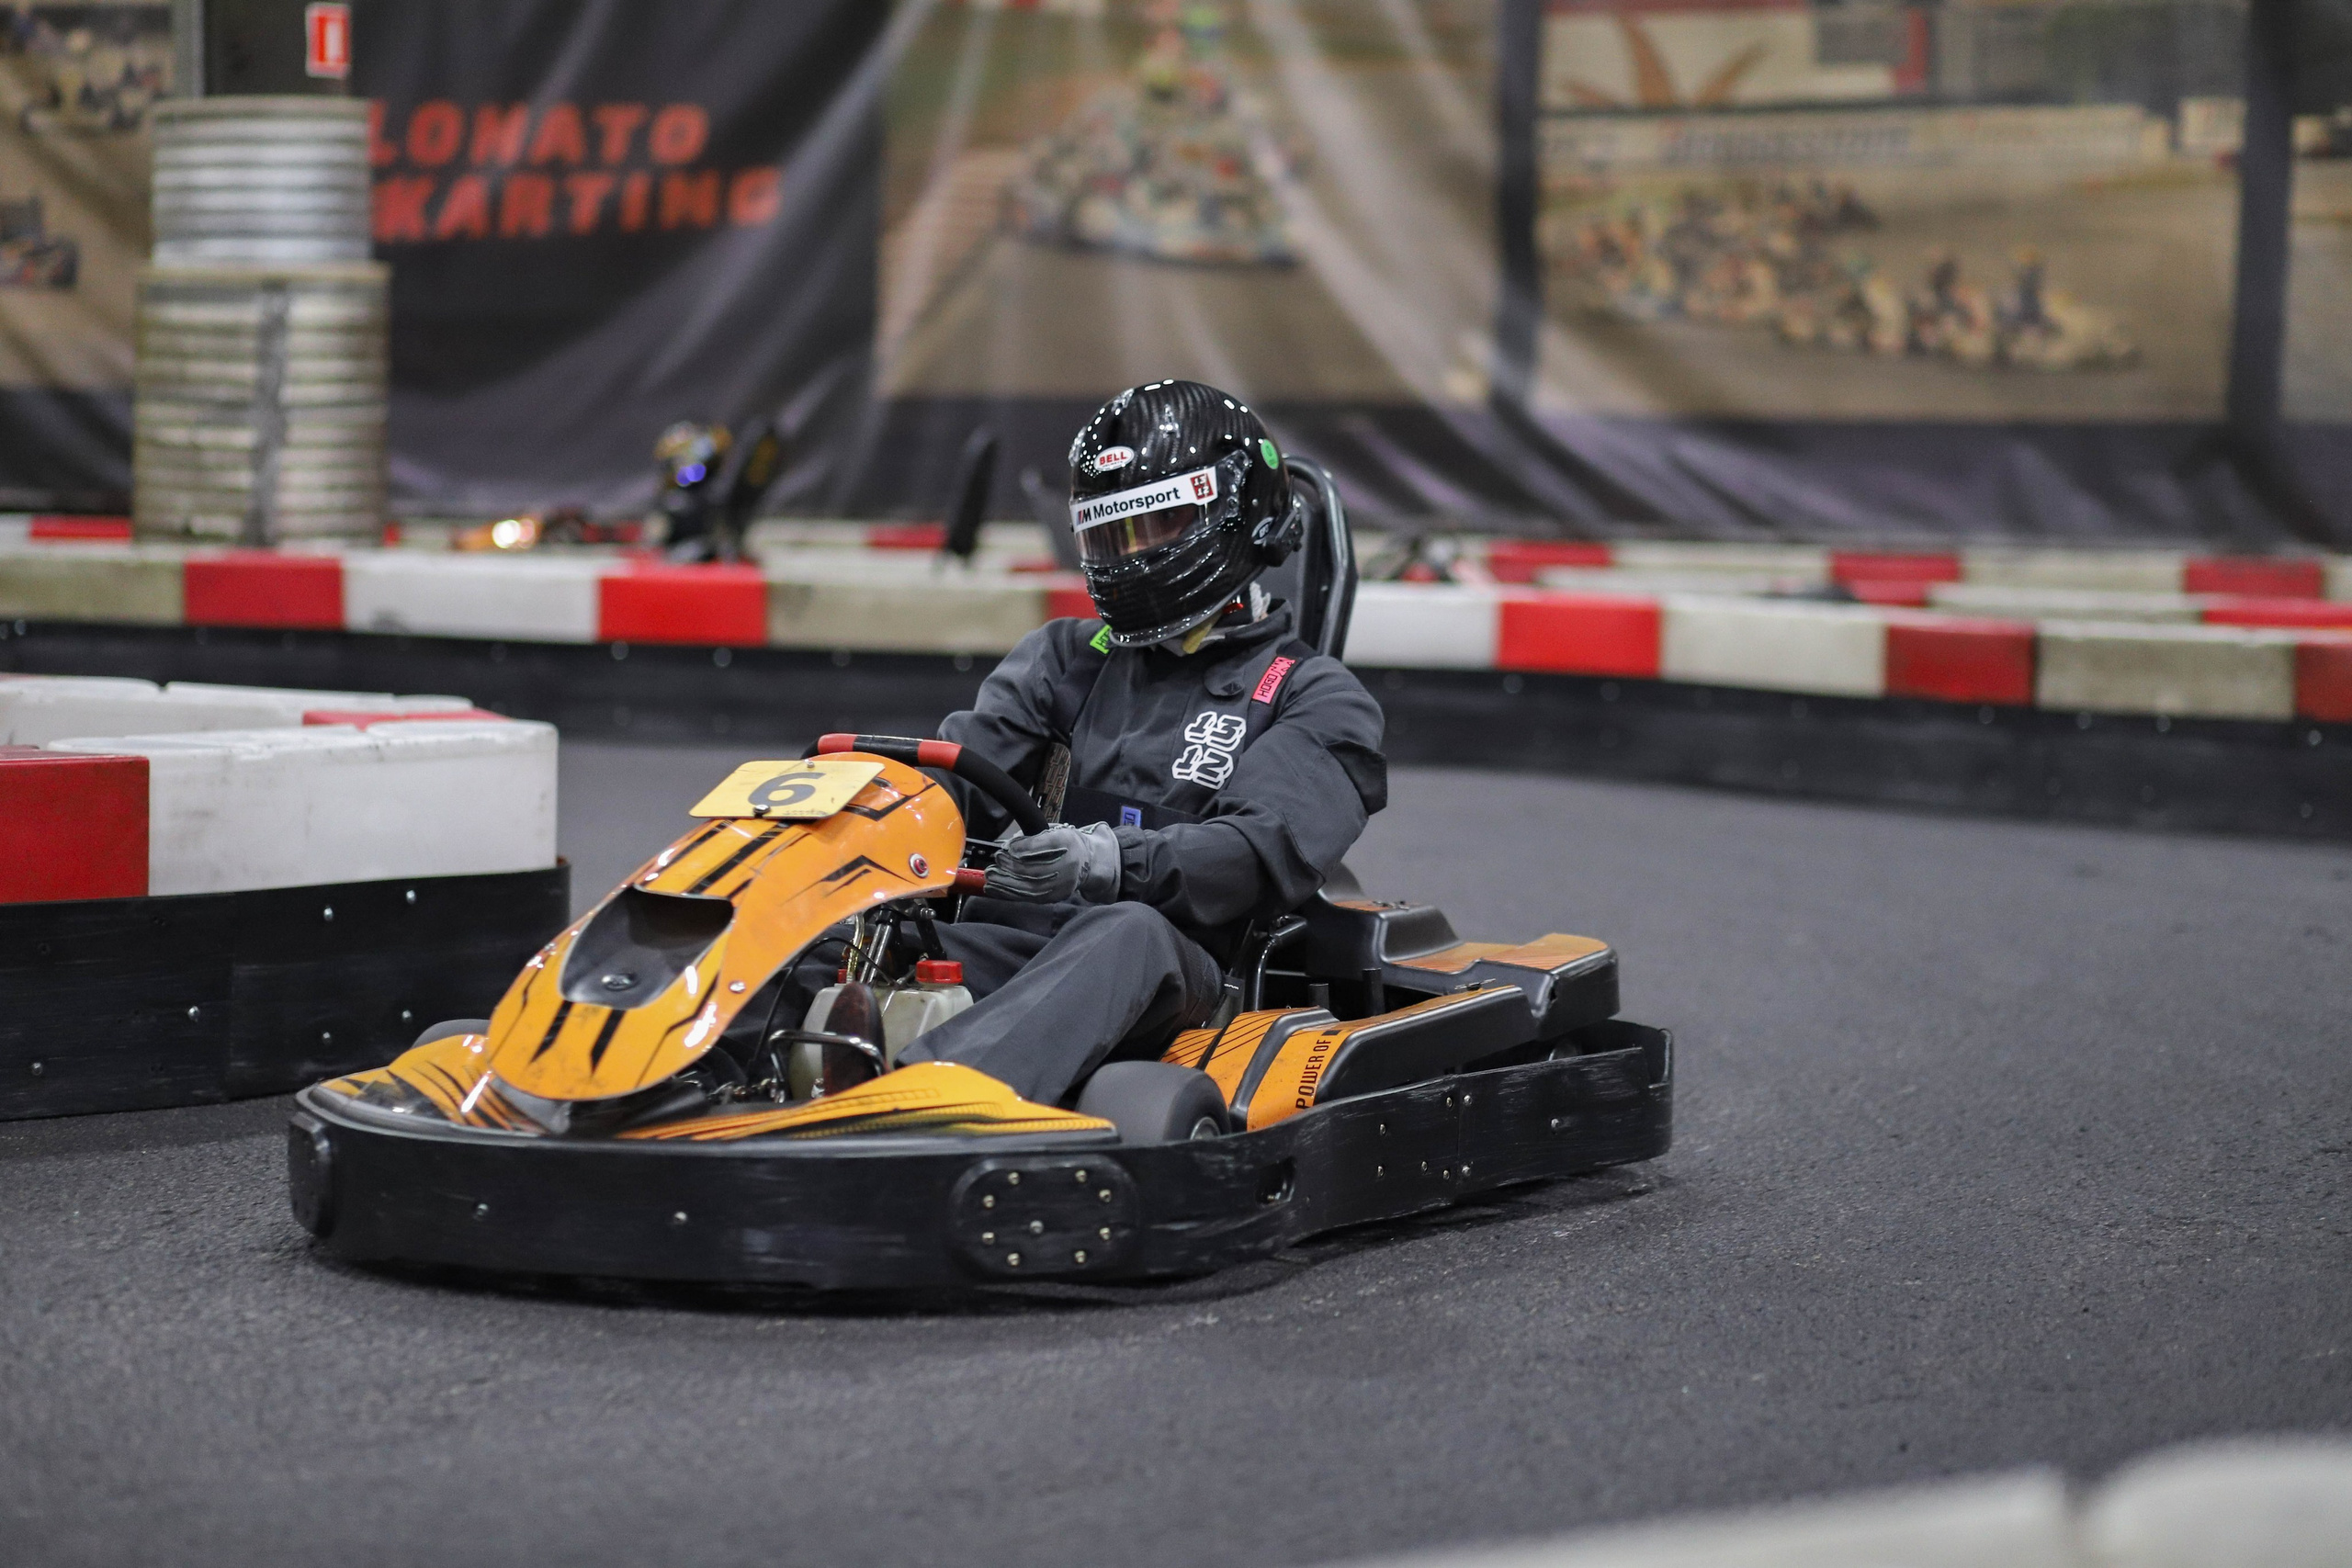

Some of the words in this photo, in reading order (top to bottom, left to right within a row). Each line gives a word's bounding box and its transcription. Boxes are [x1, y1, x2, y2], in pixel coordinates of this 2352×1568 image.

[371, 166, 785, 242] KARTING
[1099, 451, 1127, 466] BELL
[1093, 487, 1181, 519] Motorsport
[1197, 486, 1211, 497] 12
[1257, 673, 1279, 698] HOGO
[1184, 711, 1246, 751] 13
[1172, 744, 1234, 790] 12
[747, 772, 827, 807] 6
[1295, 1055, 1326, 1110] POWER
[1312, 1039, 1332, 1053] OF
